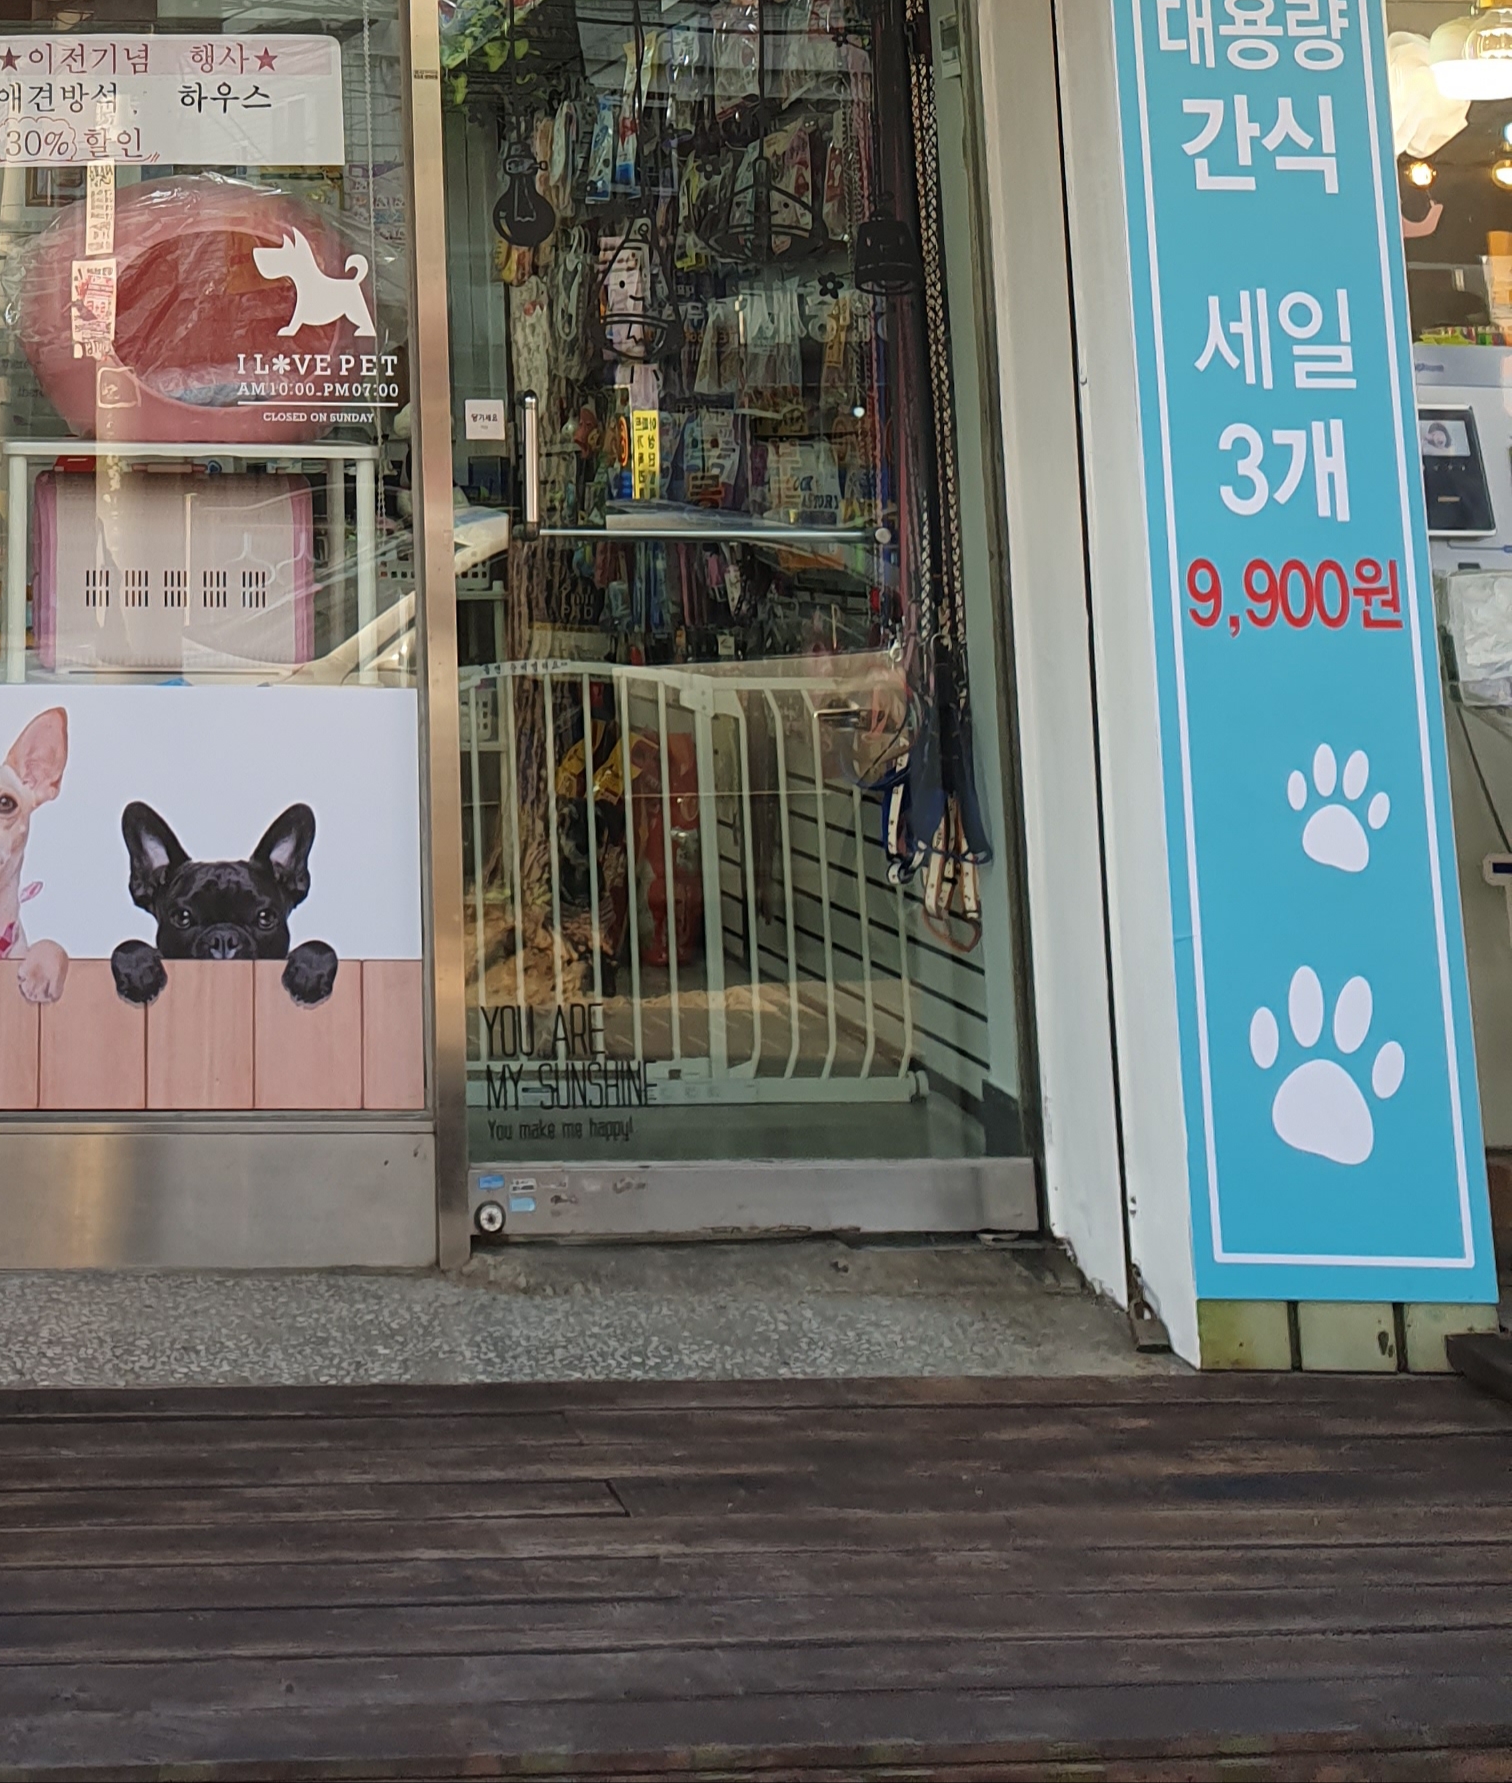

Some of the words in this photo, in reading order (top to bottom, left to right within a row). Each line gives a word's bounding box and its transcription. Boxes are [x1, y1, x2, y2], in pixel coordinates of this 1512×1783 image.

[28, 42, 150, 75] 이전기념
[189, 42, 250, 75] 행사
[177, 81, 273, 115] 하우스
[4, 128, 70, 158] 30%
[82, 126, 144, 159] 할인
[1181, 93, 1340, 195] 간식
[1193, 288, 1358, 391] 세일
[236, 353, 247, 375] I
[339, 354, 398, 377] PET
[263, 412, 308, 423] CLOSED
[310, 412, 328, 423] ON
[329, 412, 375, 424] SUNDAY
[470, 413, 498, 423] 당기세요
[1217, 418, 1351, 523] 3개
[1186, 556, 1405, 638] 9,900원
[480, 1003, 536, 1058] YOU
[551, 1002, 606, 1056] ARE
[485, 1063, 524, 1112] MY
[538, 1059, 658, 1111] SUNSHINE
[487, 1118, 514, 1140] You
[519, 1117, 557, 1140] make
[561, 1120, 584, 1139] me
[589, 1115, 634, 1143] happy!
